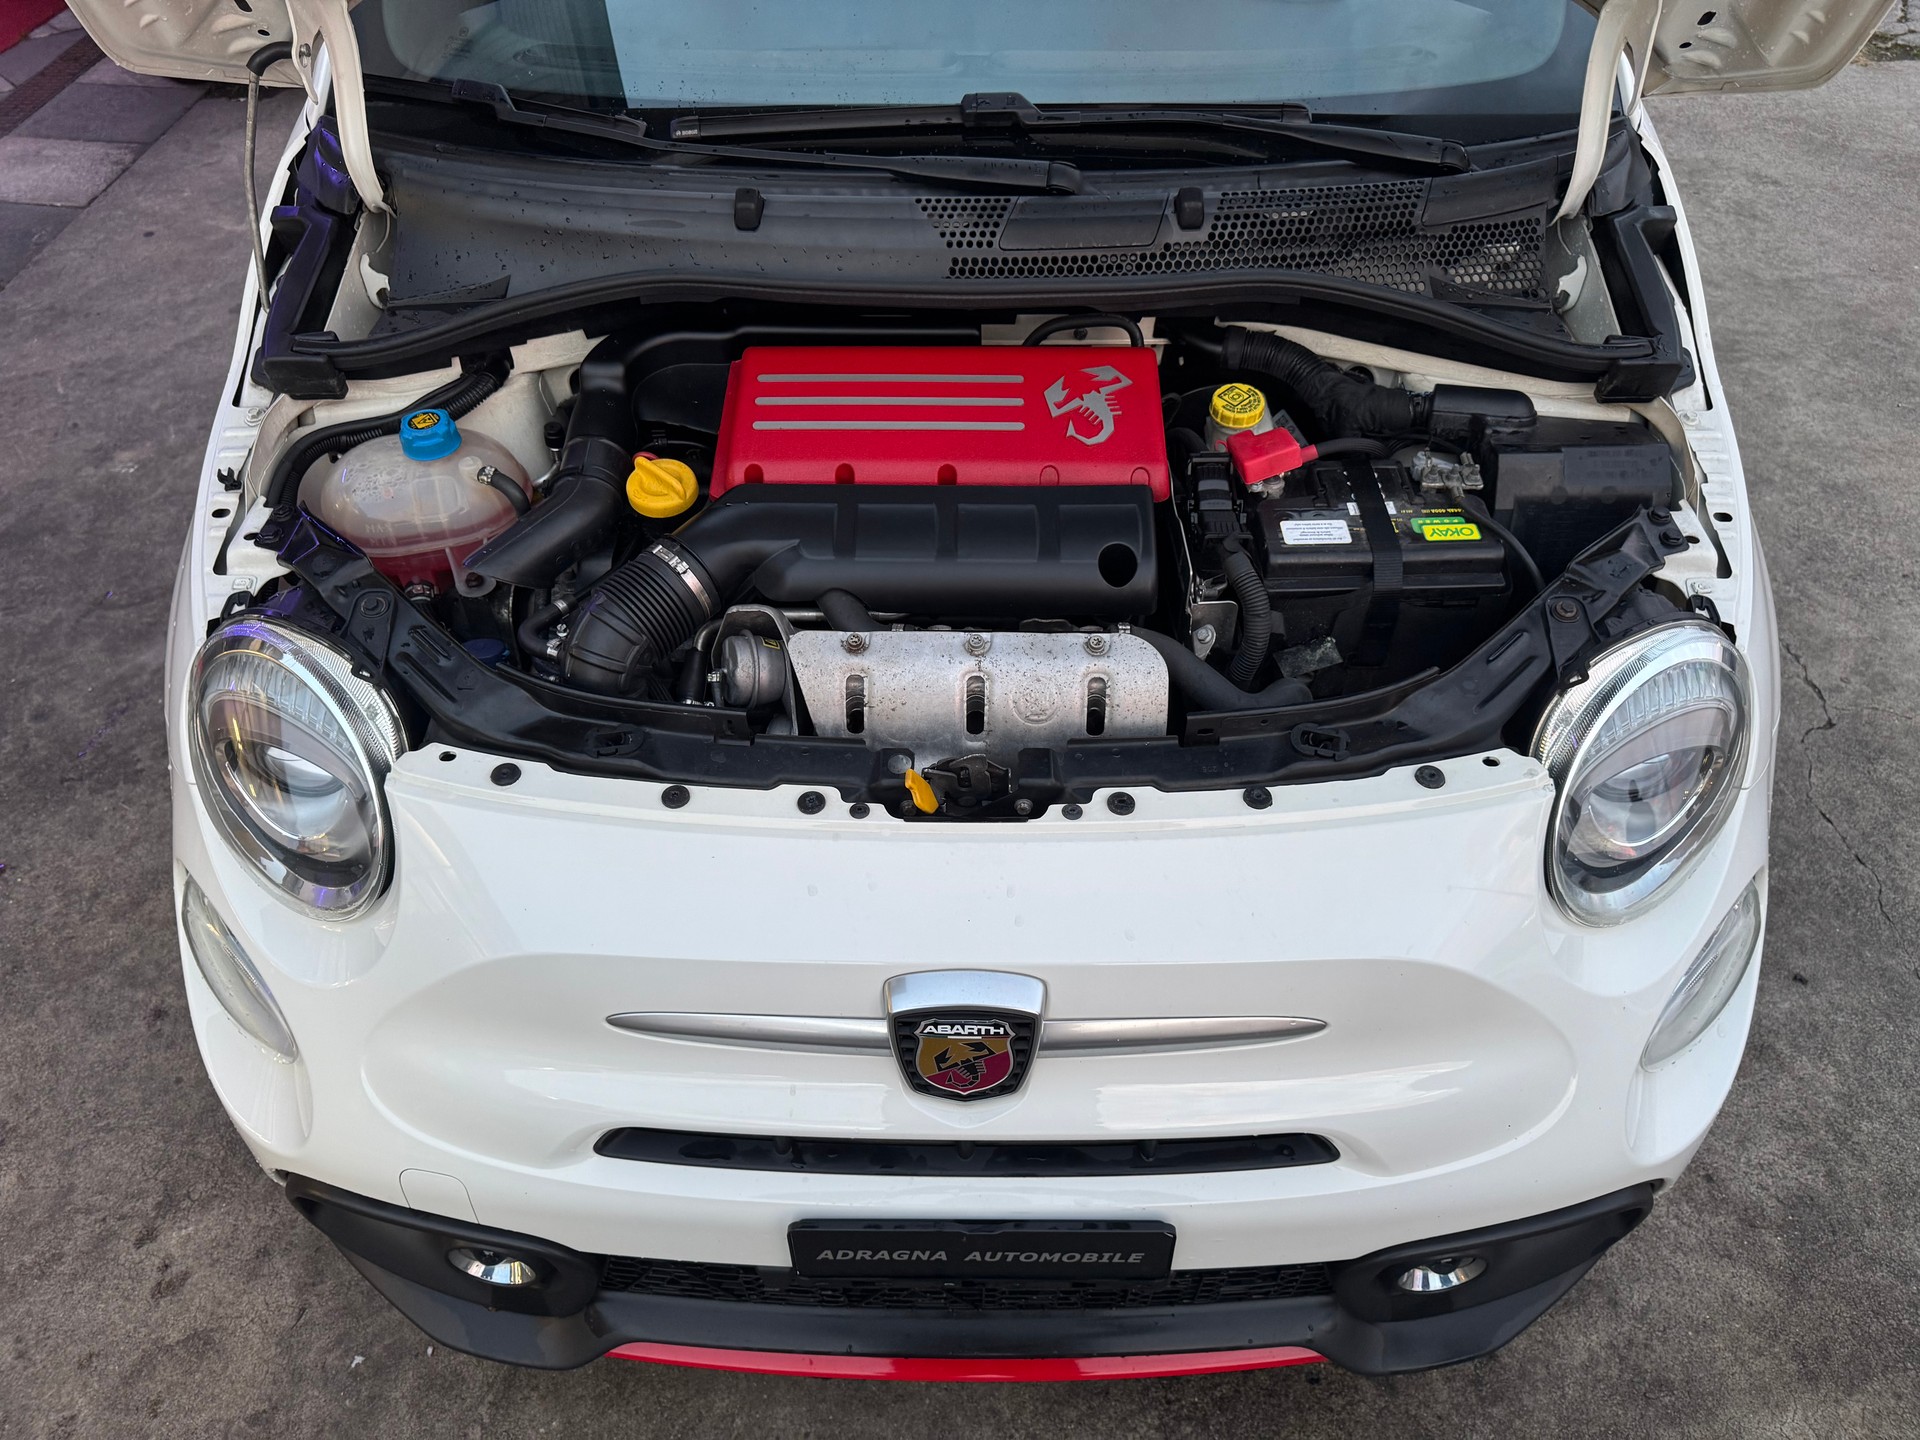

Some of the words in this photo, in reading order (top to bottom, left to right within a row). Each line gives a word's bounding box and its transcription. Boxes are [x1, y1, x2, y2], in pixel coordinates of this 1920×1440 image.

[1429, 526, 1475, 538] OKAY
[922, 1024, 1005, 1035] ABARTH
[816, 1249, 948, 1261] ADRAGNA
[963, 1251, 1145, 1263] AUTOMOBILE
